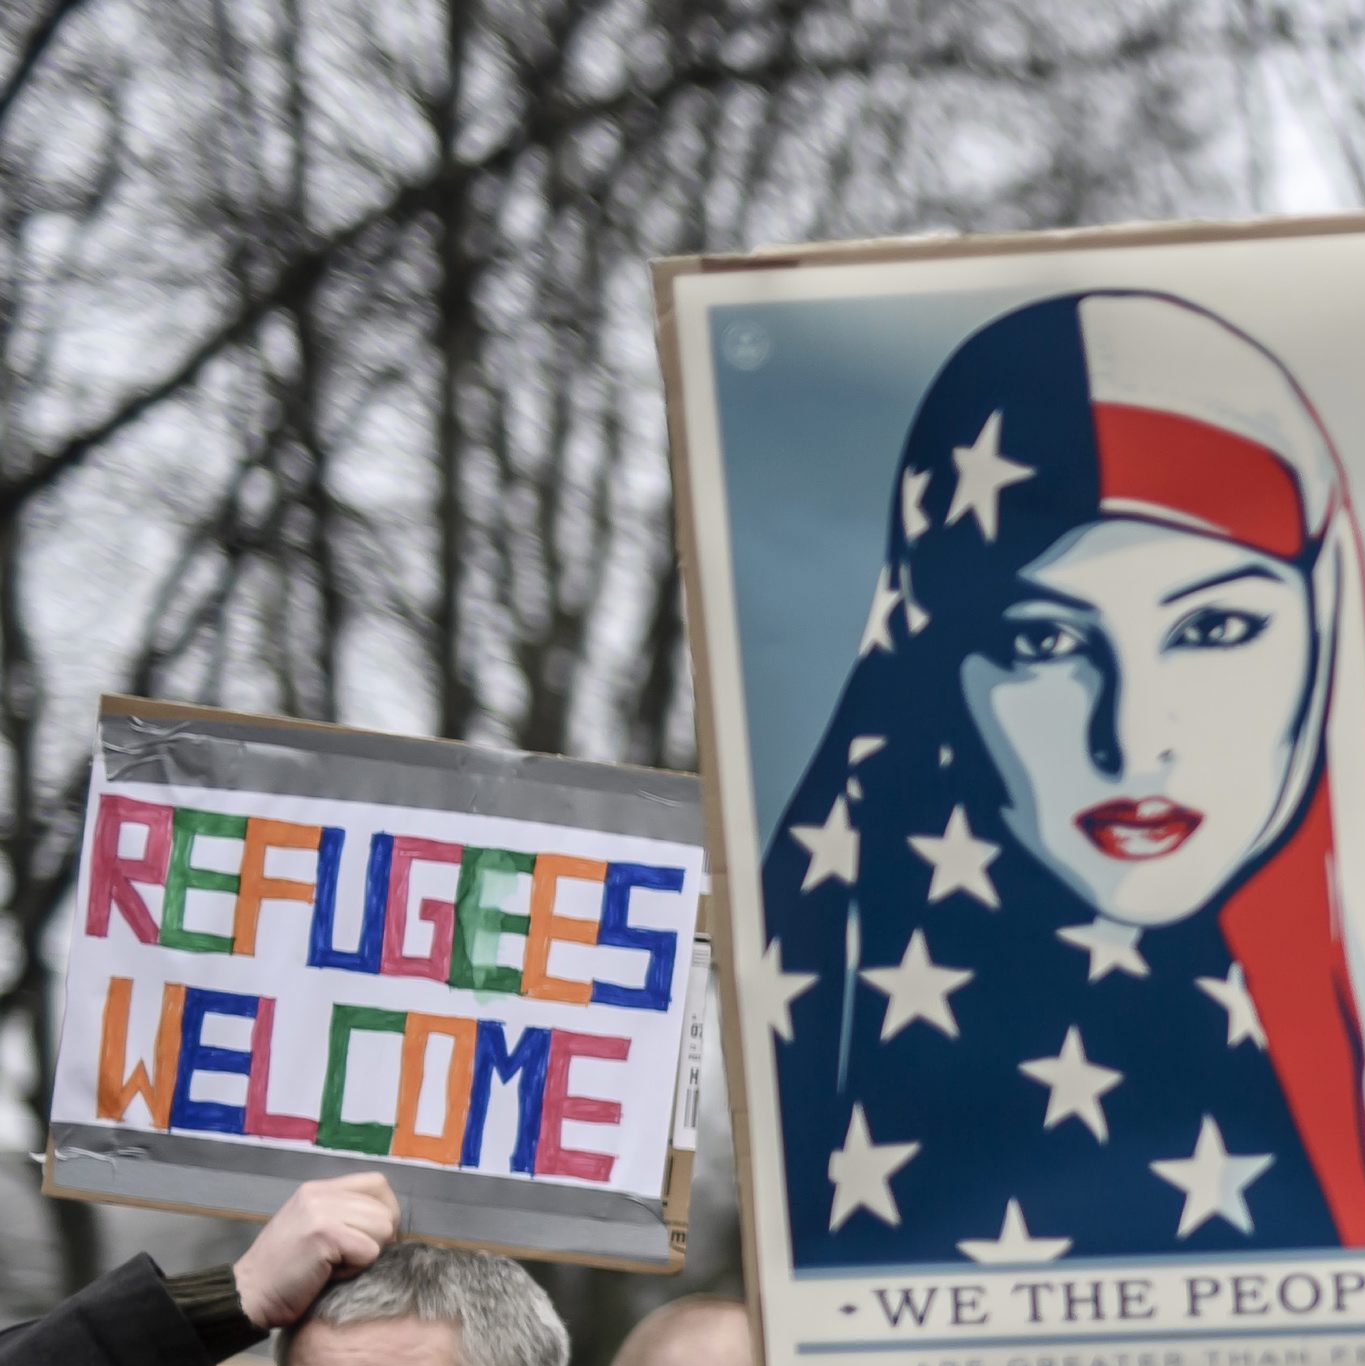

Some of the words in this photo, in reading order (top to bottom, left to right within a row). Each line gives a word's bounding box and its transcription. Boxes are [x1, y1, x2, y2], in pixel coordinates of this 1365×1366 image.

[85, 793, 686, 1012] REFUGEES
[96, 976, 631, 1182] WELCOME
[873, 1284, 990, 1329] WE
[1010, 1278, 1157, 1325] THE
